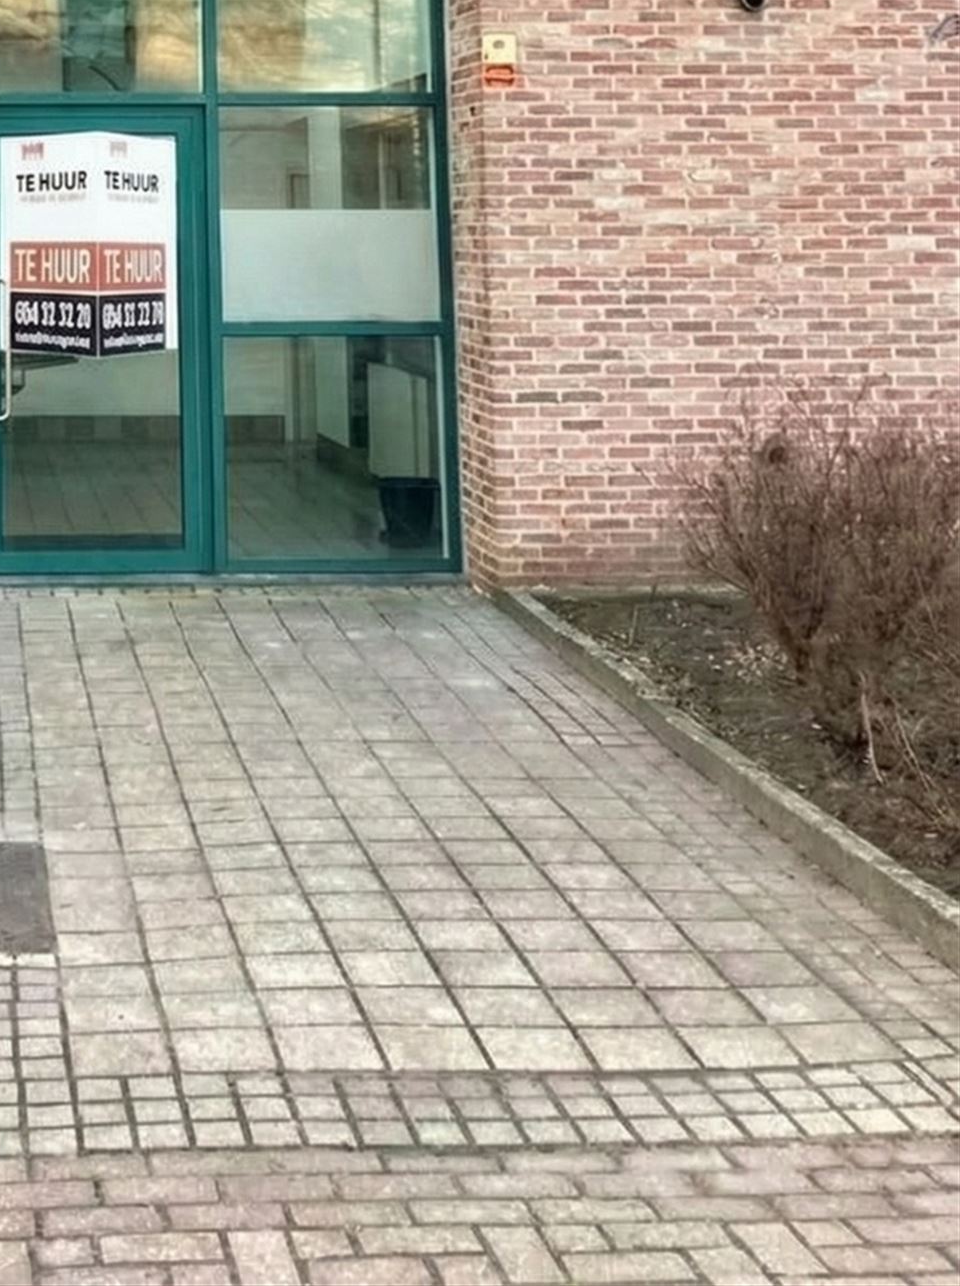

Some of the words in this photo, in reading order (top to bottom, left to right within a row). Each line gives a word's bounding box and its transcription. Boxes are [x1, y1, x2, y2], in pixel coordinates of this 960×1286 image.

[16, 174, 35, 192] TE
[39, 171, 87, 191] HUUR
[104, 170, 120, 190] TE
[122, 172, 159, 192] HUUR
[14, 249, 37, 282] TE
[41, 249, 91, 283] HUUR
[104, 249, 122, 283] TE
[124, 249, 163, 283] HUUR
